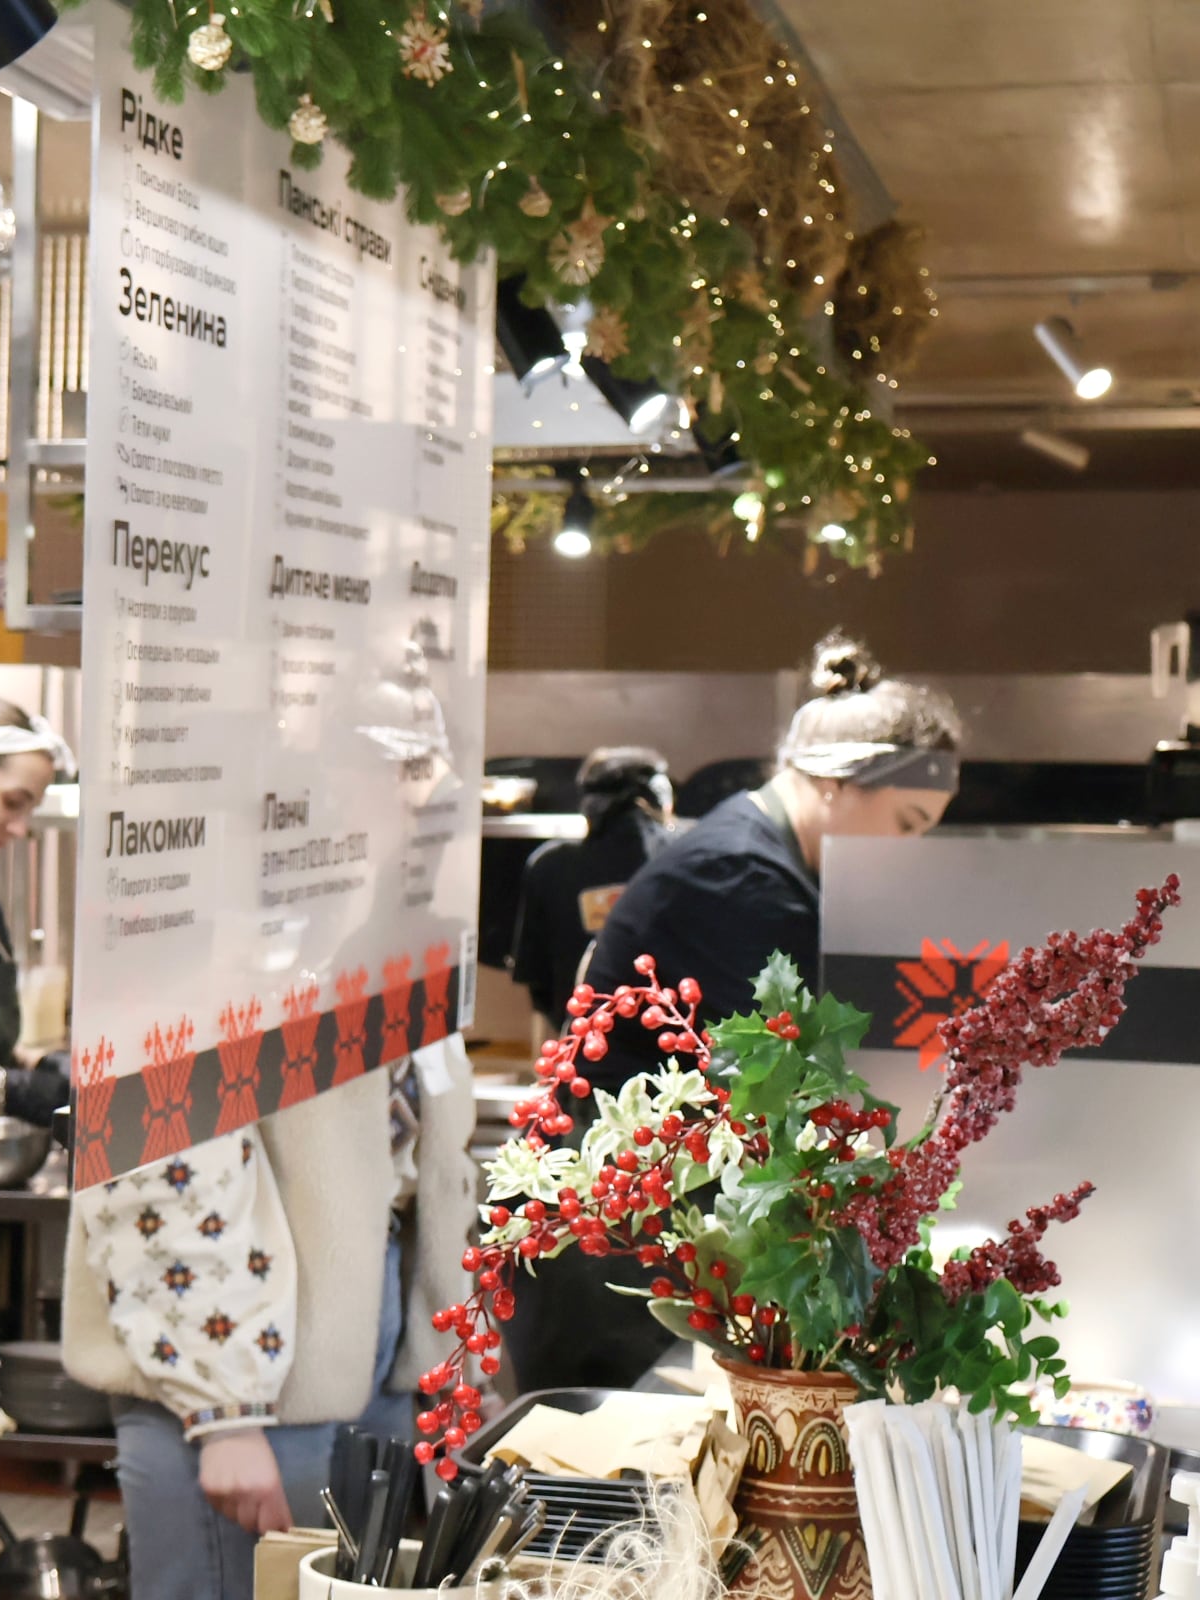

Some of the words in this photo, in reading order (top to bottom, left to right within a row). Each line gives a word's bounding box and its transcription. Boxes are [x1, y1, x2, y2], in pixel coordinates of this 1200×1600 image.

[120, 88, 184, 160] Рідке
[278, 169, 341, 238] Панські
[345, 217, 393, 268] страви
[119, 267, 227, 348] Зеленина
[112, 520, 210, 590] Перекус
[269, 554, 329, 604] Дитяче
[332, 573, 370, 605] меню
[106, 810, 207, 858] Лакомки
[262, 787, 309, 832] Ланчі
